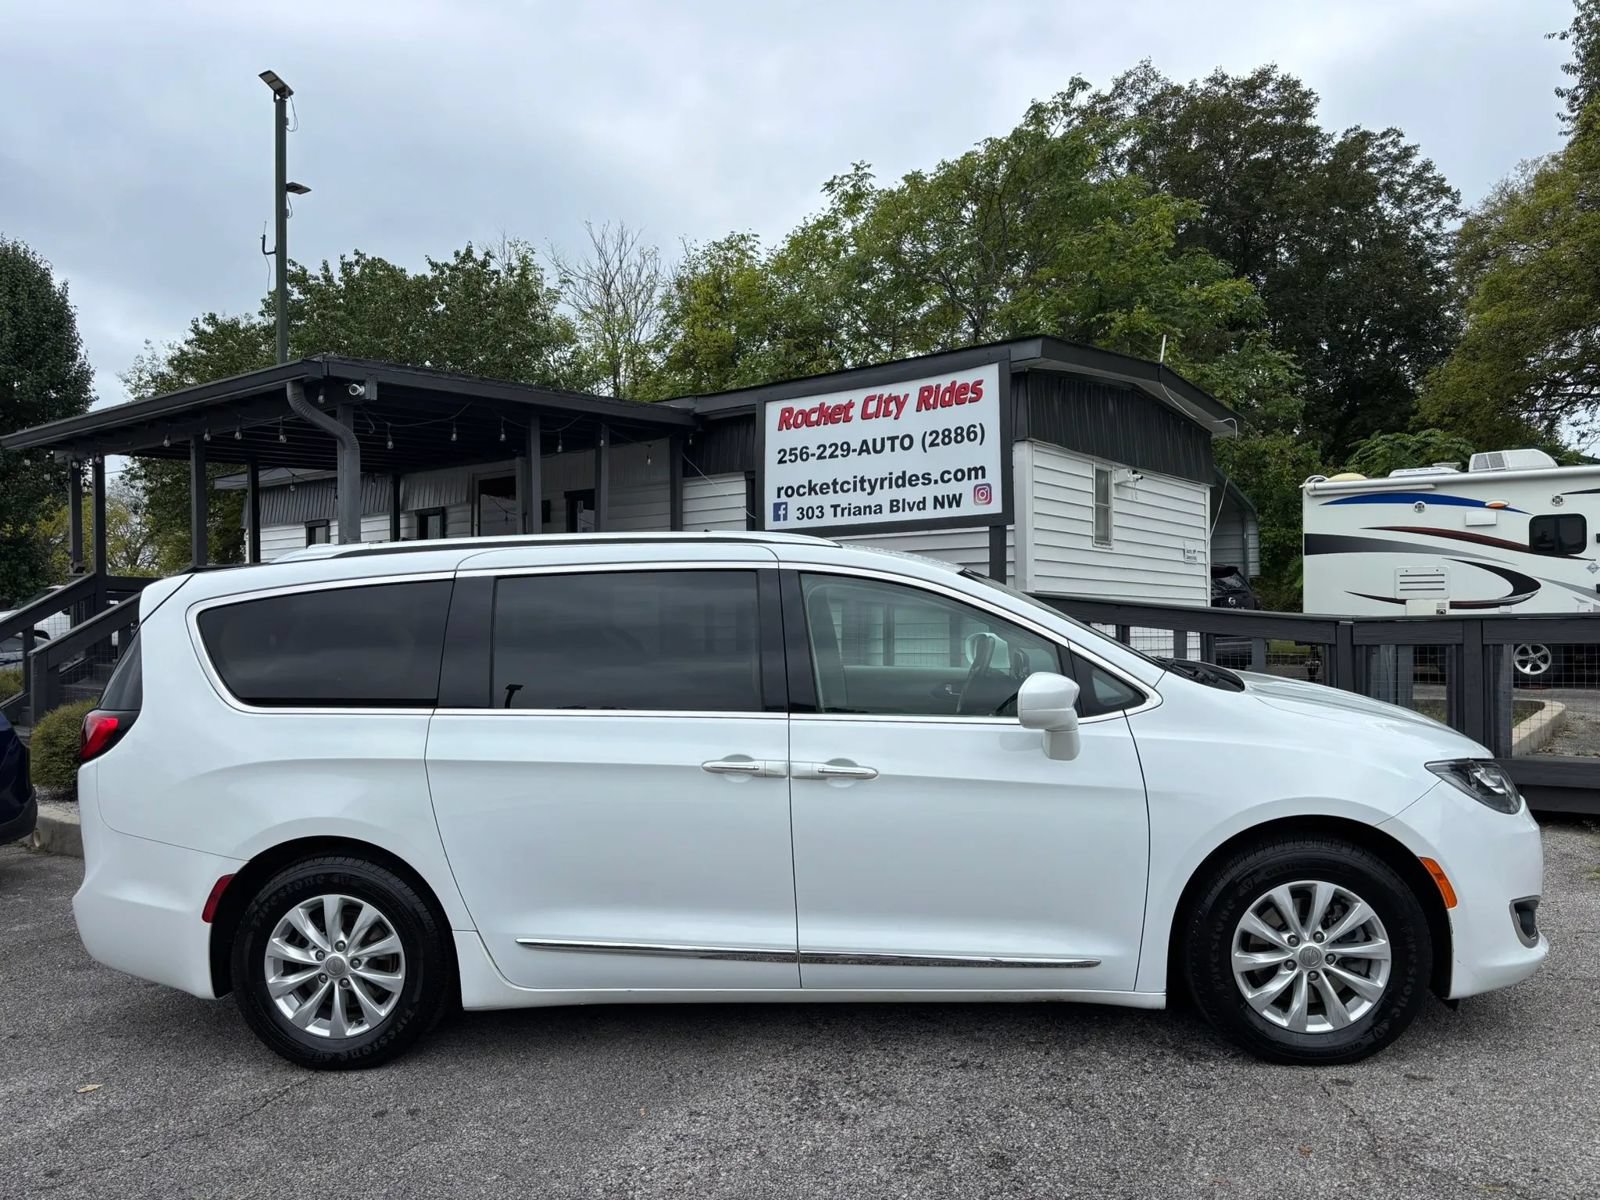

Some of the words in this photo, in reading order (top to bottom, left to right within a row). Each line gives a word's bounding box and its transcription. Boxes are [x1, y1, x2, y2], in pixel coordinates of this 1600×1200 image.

[778, 400, 855, 431] Rocket
[860, 393, 910, 420] City
[916, 379, 984, 412] Rides
[777, 434, 914, 465] 256-229-AUTO
[921, 423, 985, 453] (2886)
[776, 465, 986, 499] rocketcityrides.com
[796, 505, 825, 521] 303
[830, 501, 883, 519] Triana
[889, 497, 926, 514] Blvd
[933, 493, 963, 509] NW
